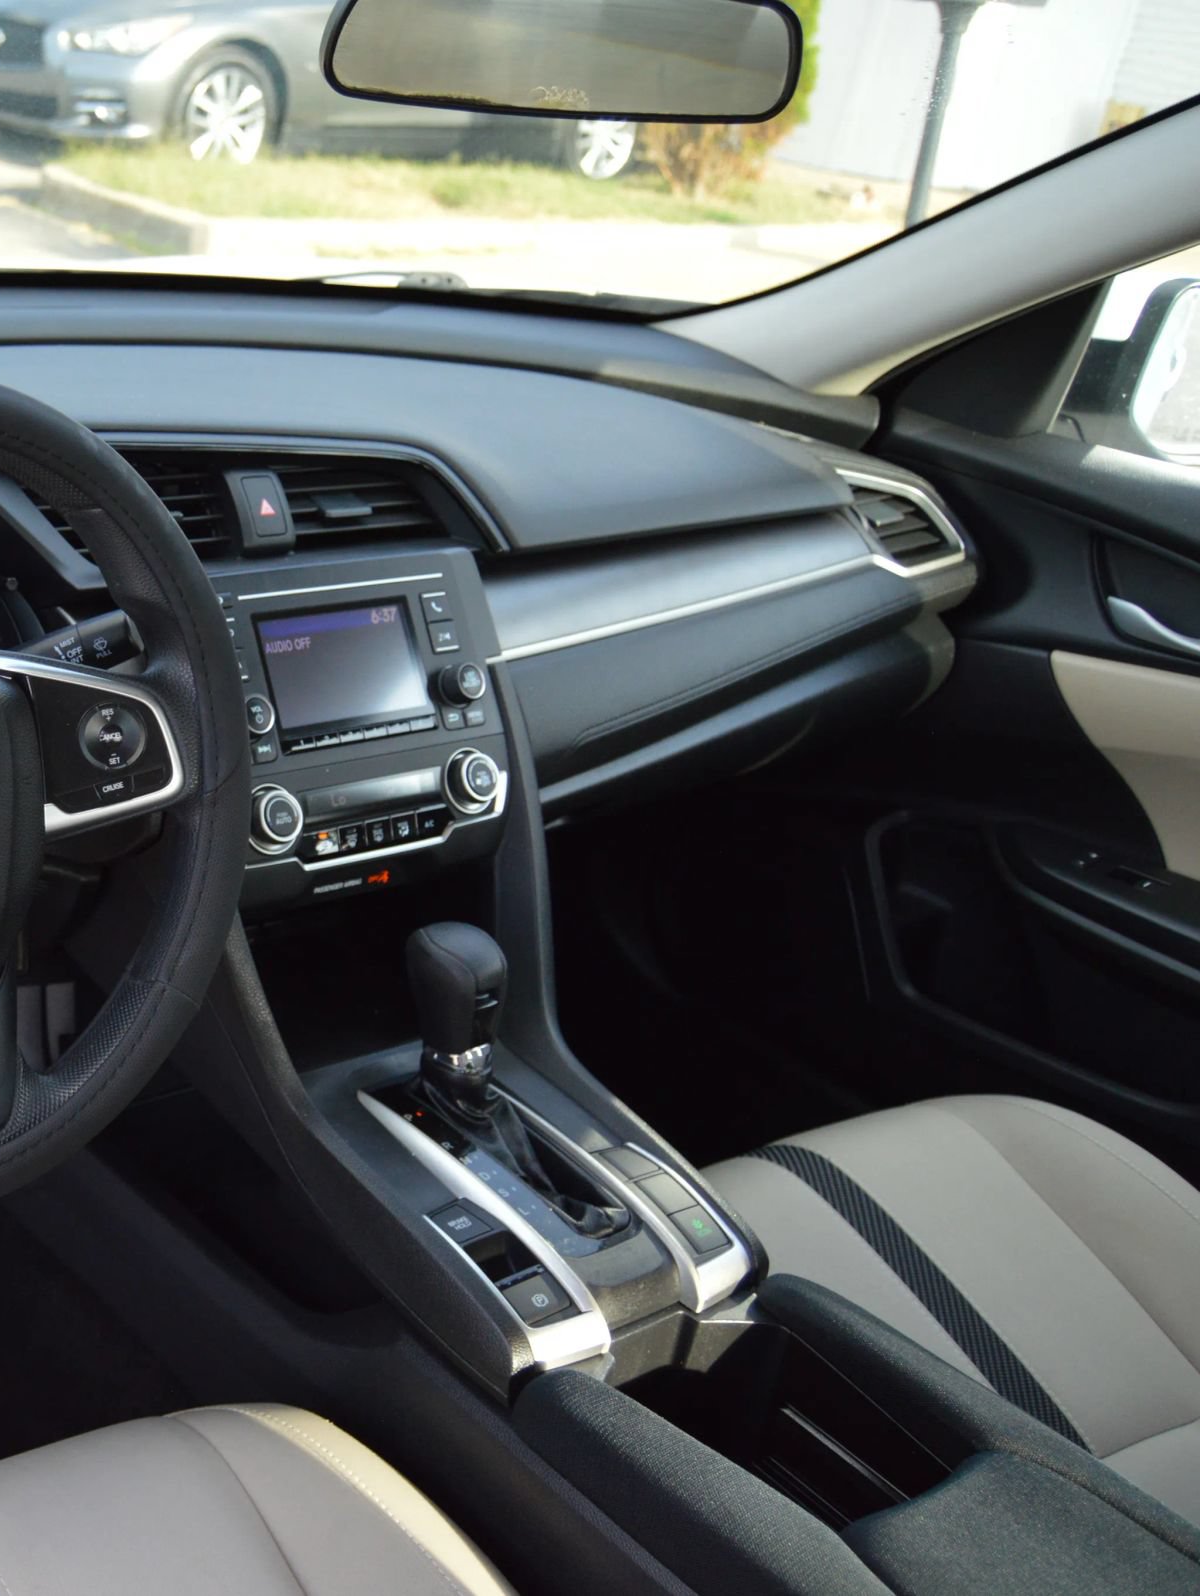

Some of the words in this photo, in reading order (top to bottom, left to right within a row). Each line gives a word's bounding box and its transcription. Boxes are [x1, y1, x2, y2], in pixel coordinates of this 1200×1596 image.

[59, 637, 75, 648] MIST
[265, 639, 293, 654] AUDIO
[294, 637, 311, 650] OFF
[66, 646, 82, 659] OFF
[101, 708, 114, 716] RES
[109, 757, 121, 765] SET
[102, 781, 125, 793] CRUISE
